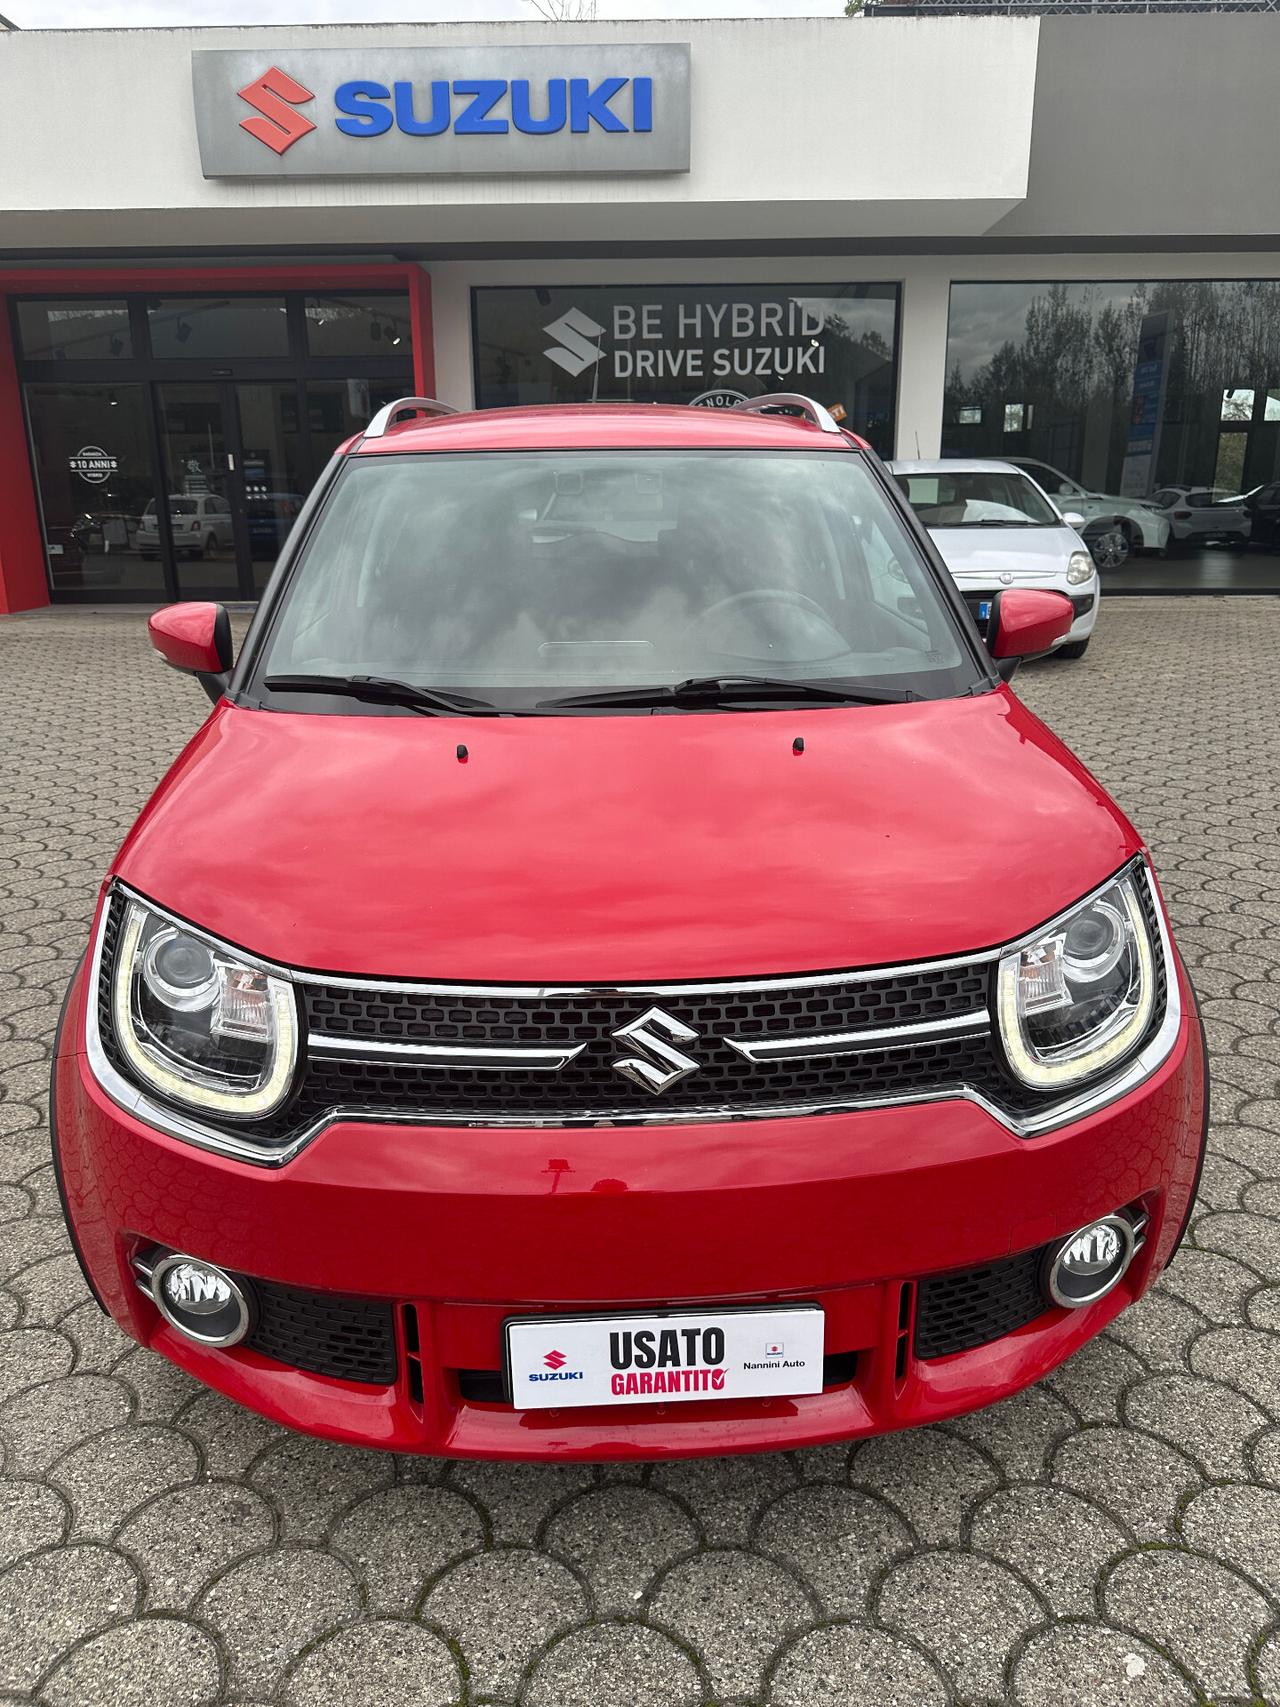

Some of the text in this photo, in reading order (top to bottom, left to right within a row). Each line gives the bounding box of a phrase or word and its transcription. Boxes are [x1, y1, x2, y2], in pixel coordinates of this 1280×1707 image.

[335, 77, 653, 137] SUZUKI
[613, 302, 826, 340] BE HYBRID
[614, 346, 826, 378] DRIVE SUZUKI
[77, 460, 111, 469] 10 ANNI
[610, 1328, 725, 1370] USATO
[528, 1371, 583, 1382] SUZUKI
[743, 1360, 806, 1370] Nannini Auto
[611, 1368, 729, 1396] GARANTITO
